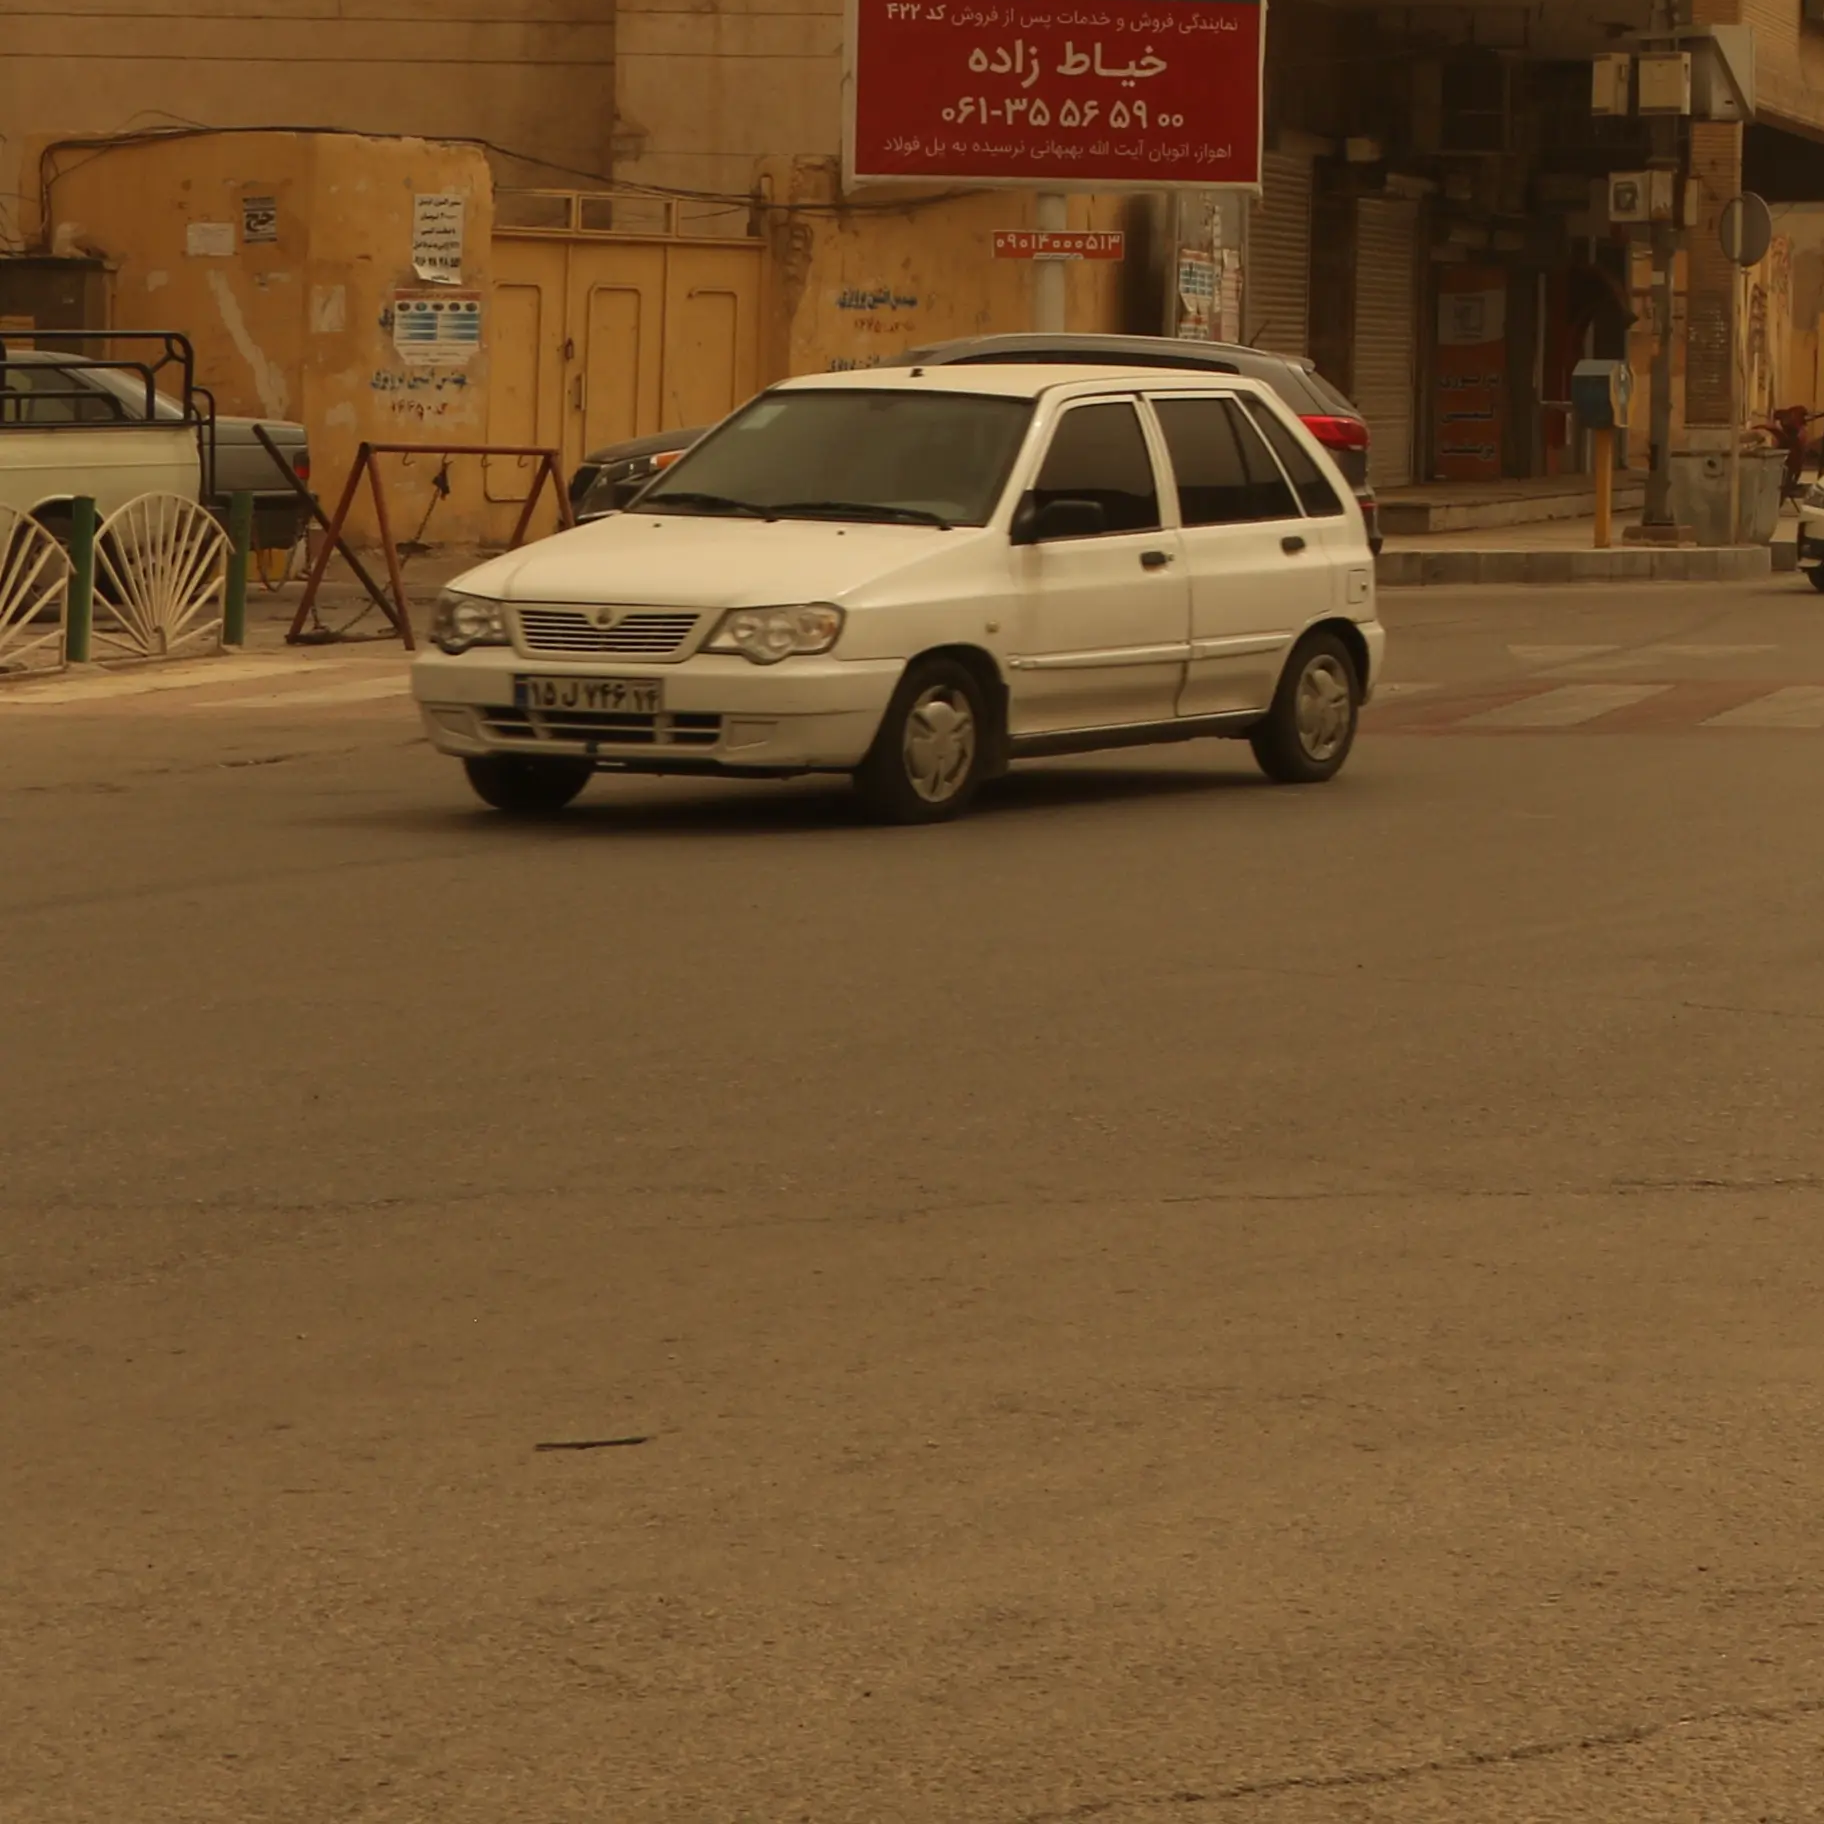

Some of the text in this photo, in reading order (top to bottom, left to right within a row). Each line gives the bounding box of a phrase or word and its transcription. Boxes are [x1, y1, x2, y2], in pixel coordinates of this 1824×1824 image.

[887, 2, 1239, 35] نمایندگی فروش و خدمات پس از فروش کد ۴۲۲
[968, 39, 1169, 88] خیاط زاده
[1059, 98, 1101, 128] ۵۶
[1108, 99, 1149, 129] ۵۹
[883, 135, 921, 153] فولاد
[925, 137, 946, 159] پل
[952, 140, 968, 156] به
[972, 139, 1026, 159] نرسیده
[1030, 141, 1085, 161] بهبهانی
[1089, 141, 1110, 157] الله
[1116, 139, 1145, 158] آیت
[1148, 142, 1190, 163] اتوبان
[996, 233, 1121, 251] ۰۹۰۱۴۰۰۰۵۱۳
